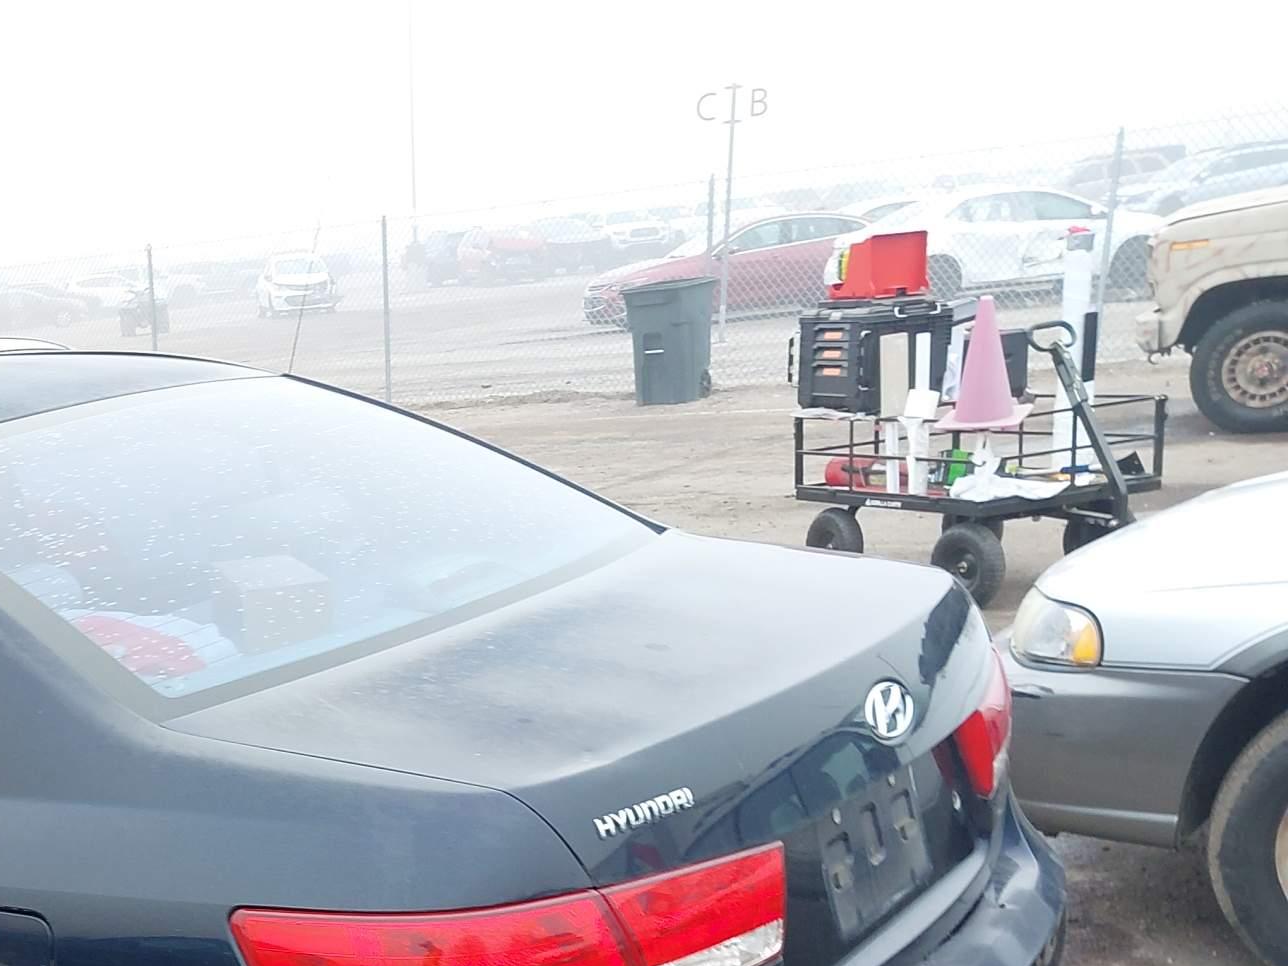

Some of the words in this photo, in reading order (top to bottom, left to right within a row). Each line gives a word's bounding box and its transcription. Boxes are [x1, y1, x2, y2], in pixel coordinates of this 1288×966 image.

[696, 92, 717, 121] C
[750, 88, 768, 116] B
[593, 787, 696, 839] HYUNDAI
